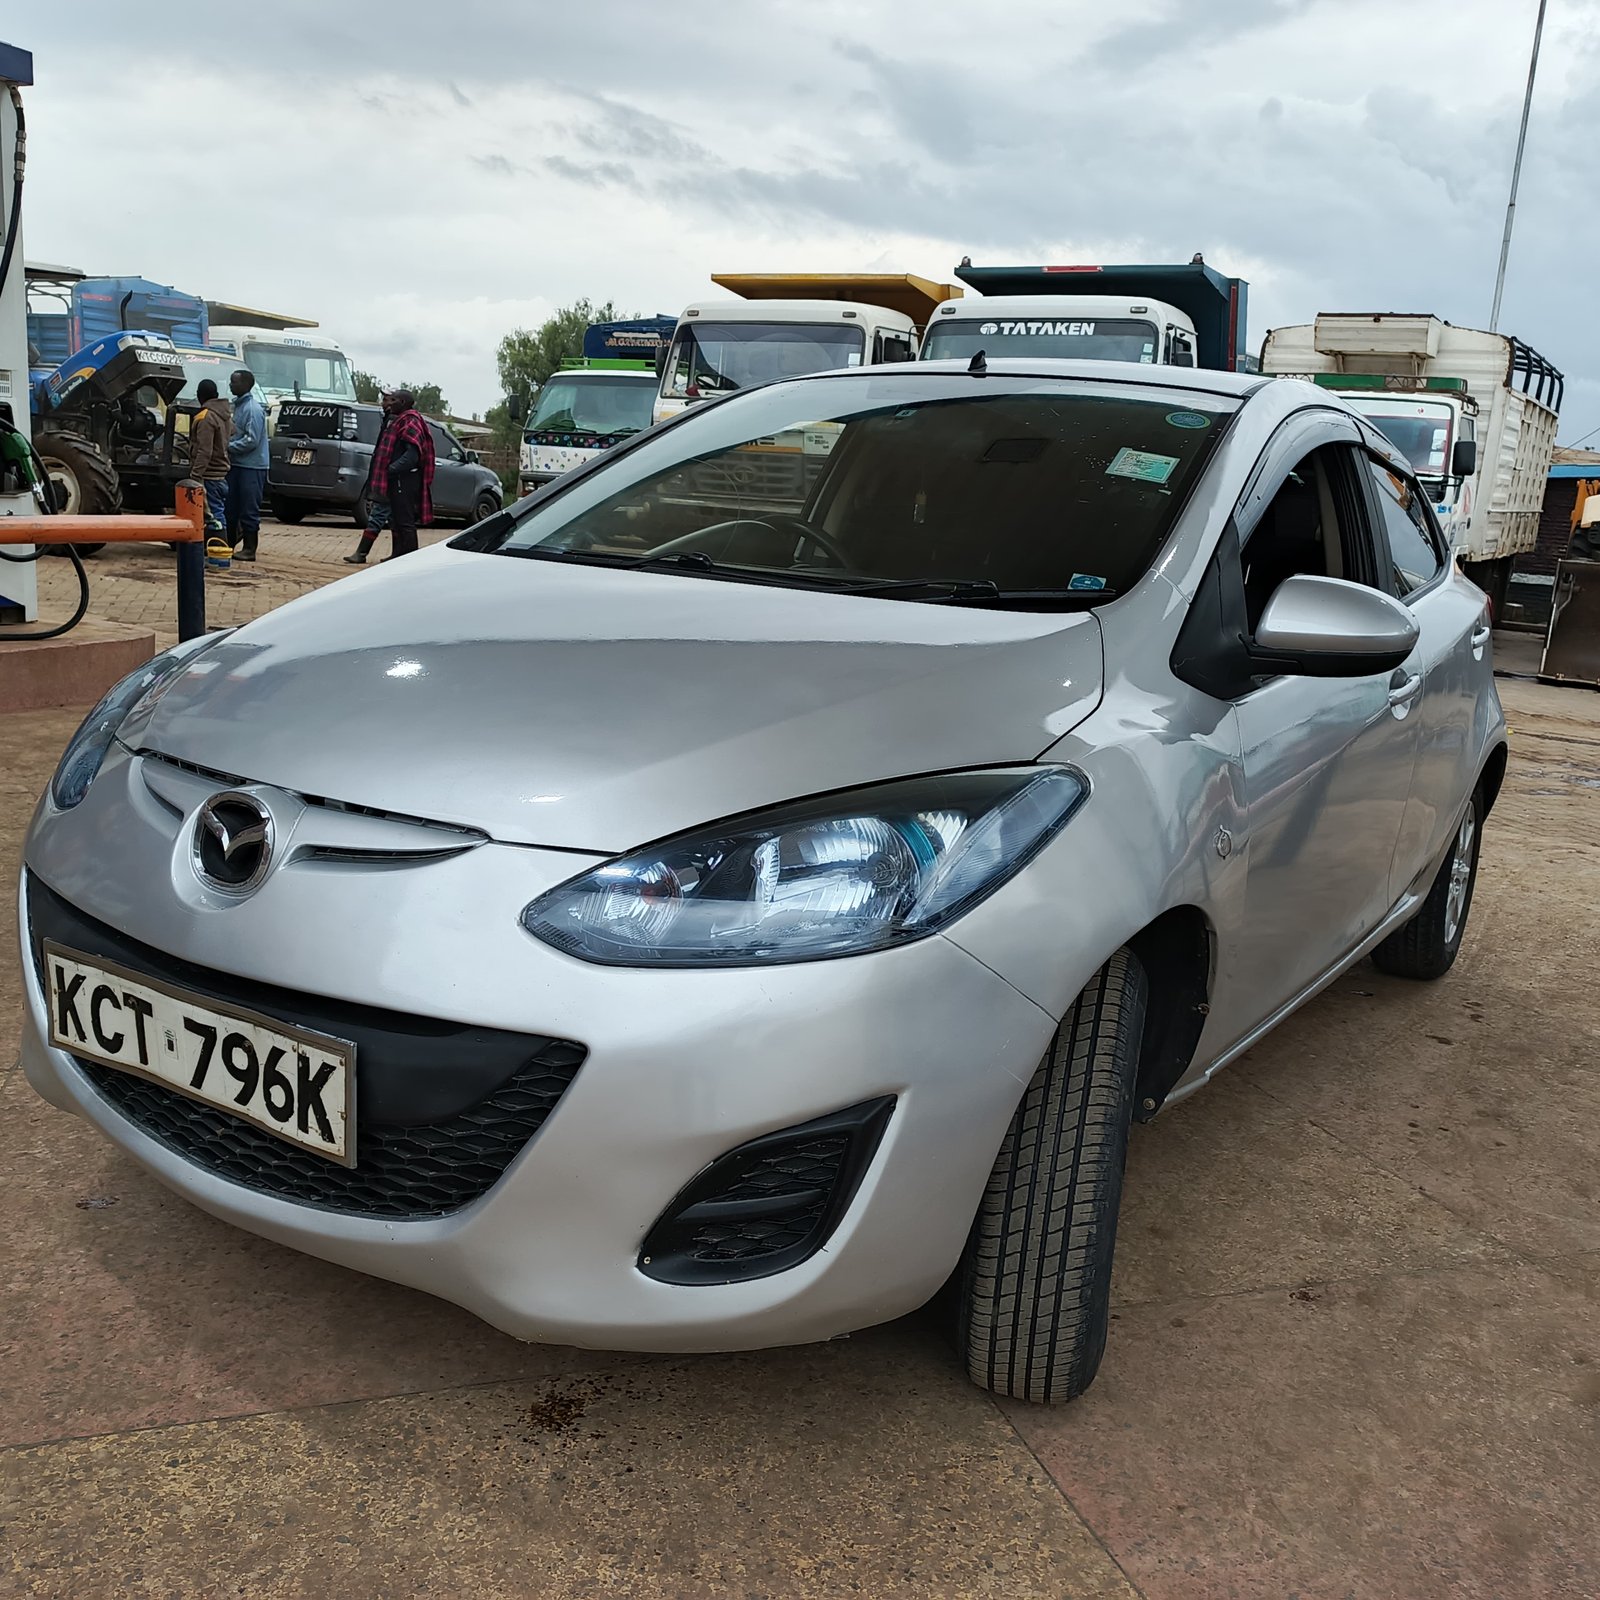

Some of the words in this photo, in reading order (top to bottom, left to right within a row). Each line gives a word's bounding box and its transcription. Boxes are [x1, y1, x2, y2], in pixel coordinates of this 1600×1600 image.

[1000, 322, 1096, 336] TATAKEN
[282, 405, 337, 418] SULTAN
[55, 963, 154, 1066] KCT
[183, 1015, 338, 1145] 796K
